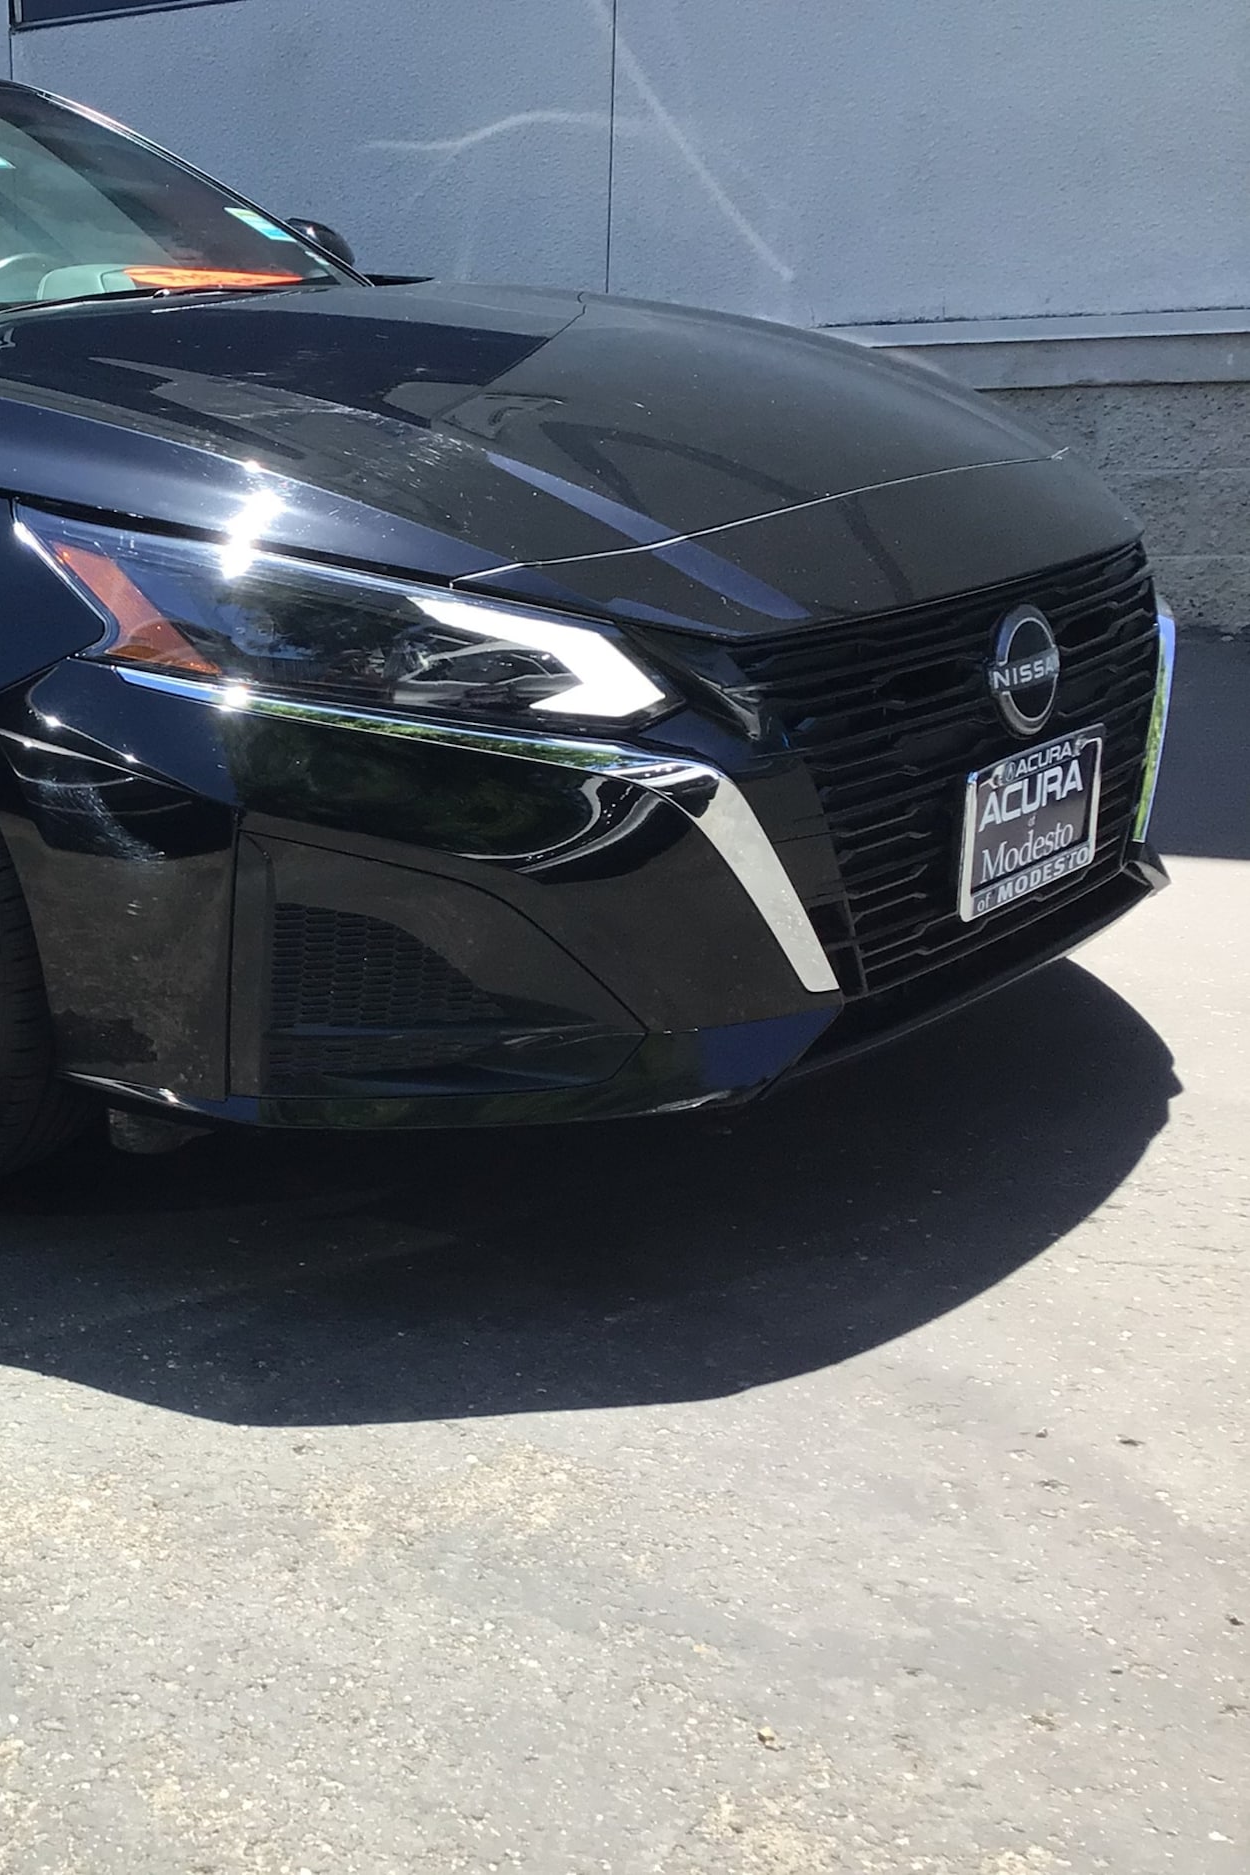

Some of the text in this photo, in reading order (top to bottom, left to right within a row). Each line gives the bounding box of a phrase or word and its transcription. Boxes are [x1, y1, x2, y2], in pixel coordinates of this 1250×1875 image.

[1015, 740, 1072, 778] ACURA
[978, 760, 1083, 832] ACURA
[977, 847, 1091, 912] of MODESTO
[980, 822, 1074, 884] Modesto
